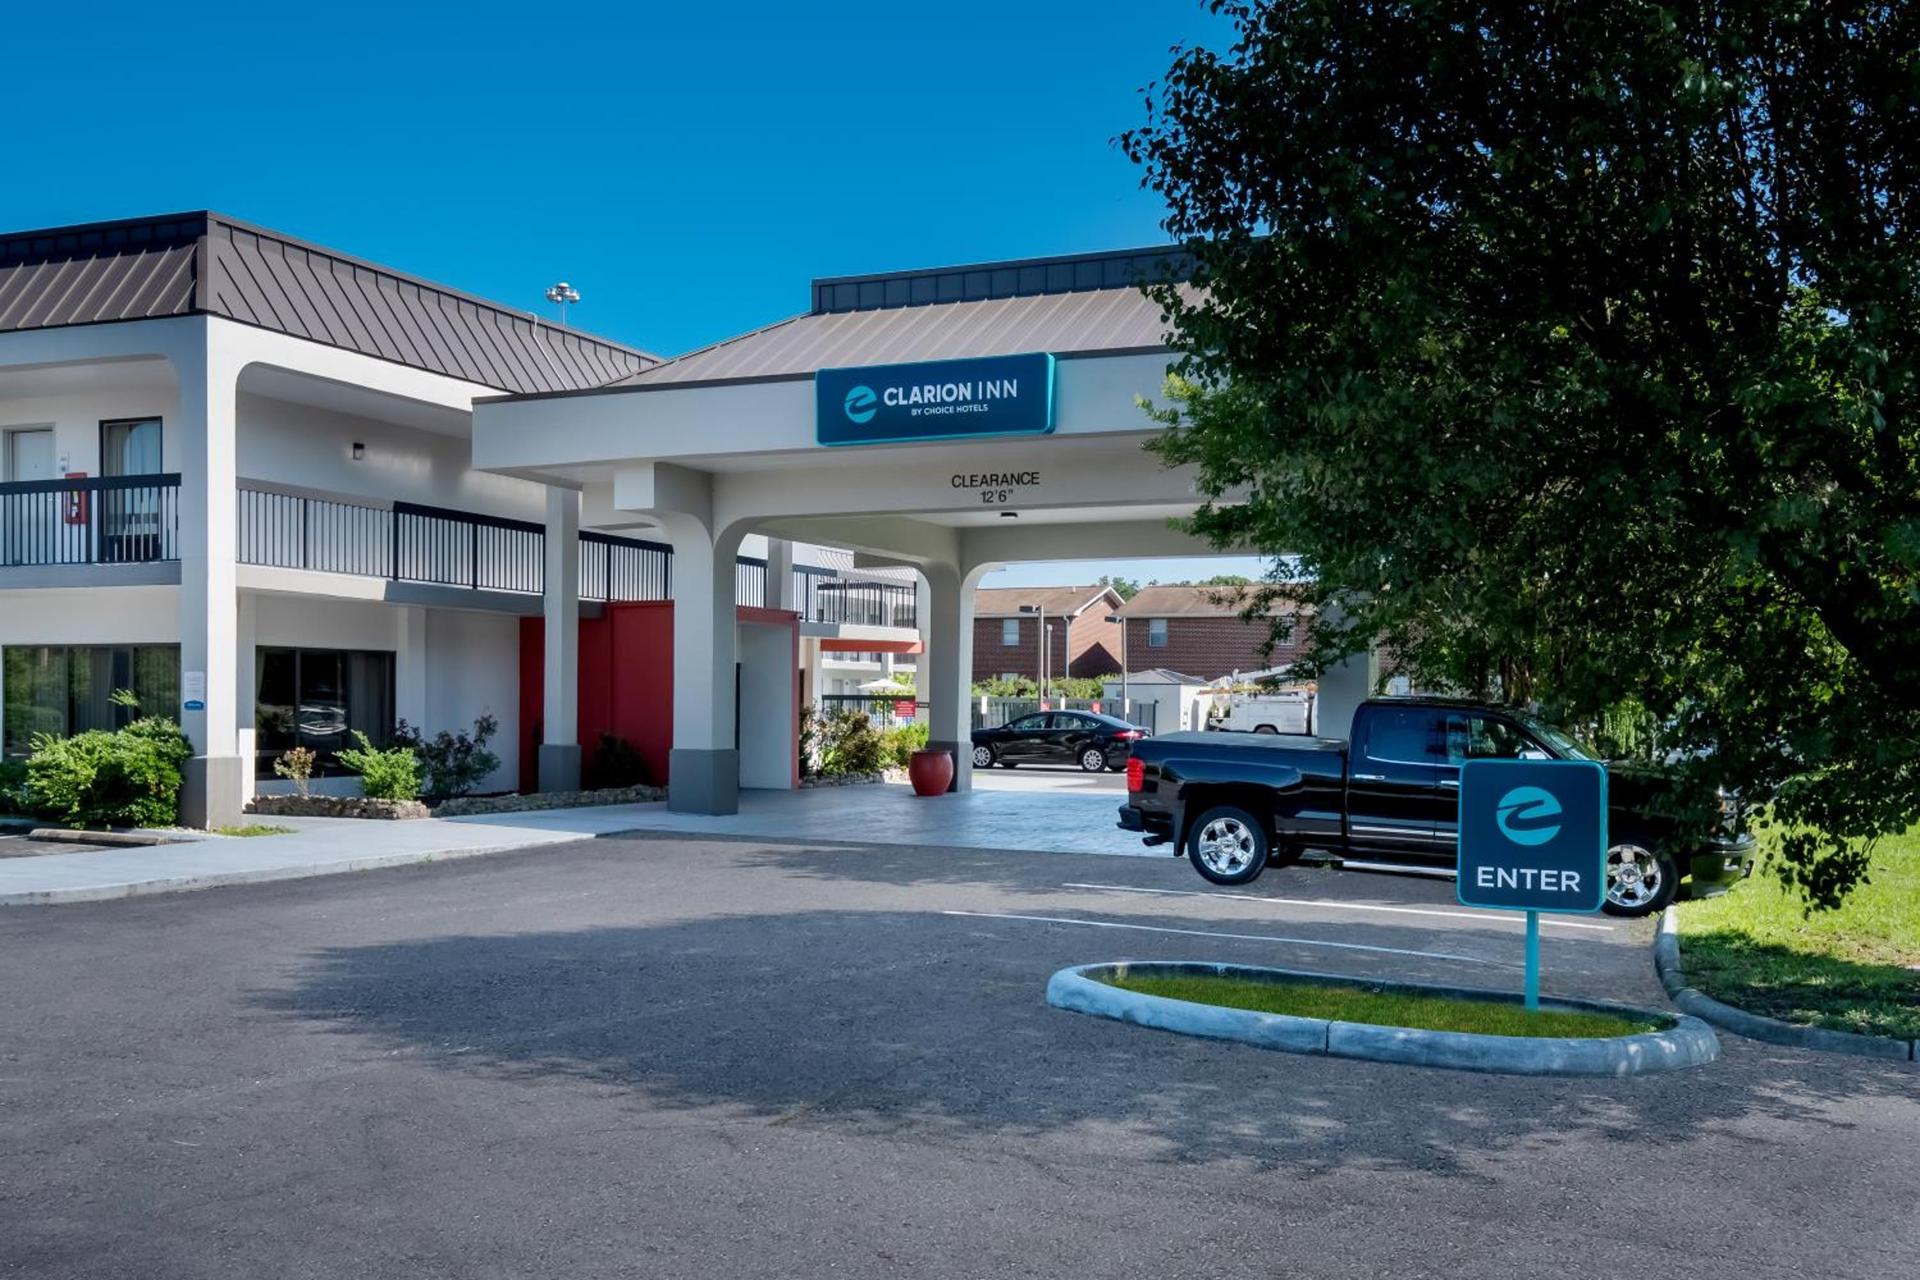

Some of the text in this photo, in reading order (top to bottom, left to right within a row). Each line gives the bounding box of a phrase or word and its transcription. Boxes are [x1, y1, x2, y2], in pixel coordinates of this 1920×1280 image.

[883, 378, 1017, 407] CLARION INN
[911, 403, 989, 416] BY CHOICE HOTELS
[951, 471, 1040, 488] CLEARANCE
[1477, 866, 1581, 892] ENTER
